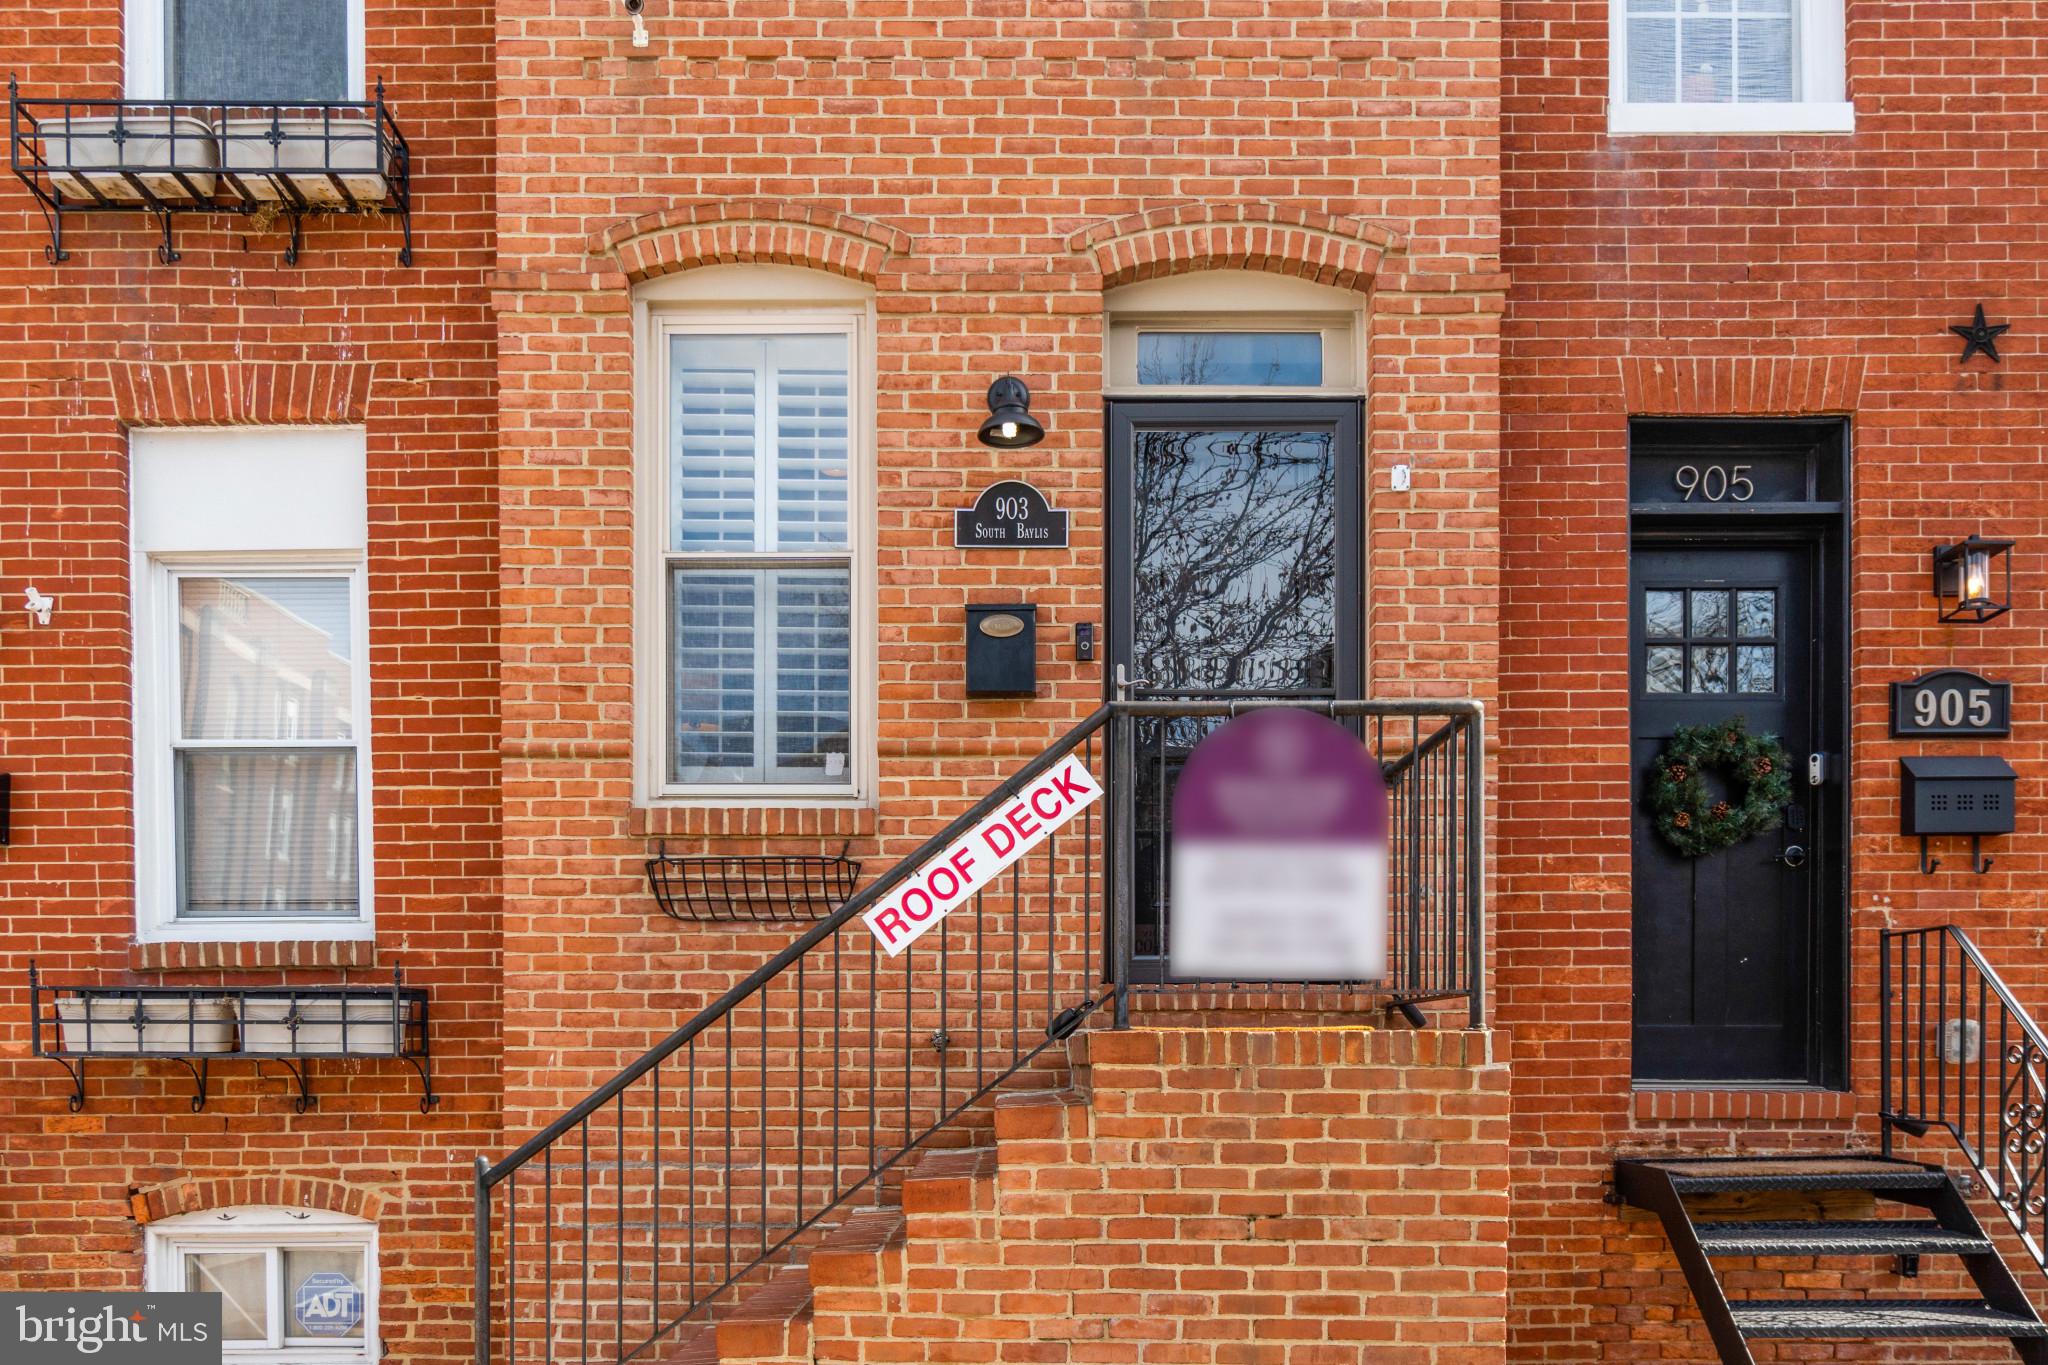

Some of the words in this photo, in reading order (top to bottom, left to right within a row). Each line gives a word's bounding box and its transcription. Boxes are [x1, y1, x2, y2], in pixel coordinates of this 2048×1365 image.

[1676, 465, 1754, 501] 905
[995, 497, 1029, 520] 903
[1914, 688, 1992, 727] 905
[873, 846, 976, 944] ROOF
[981, 765, 1091, 859] DECK
[305, 1292, 353, 1318] ADT
